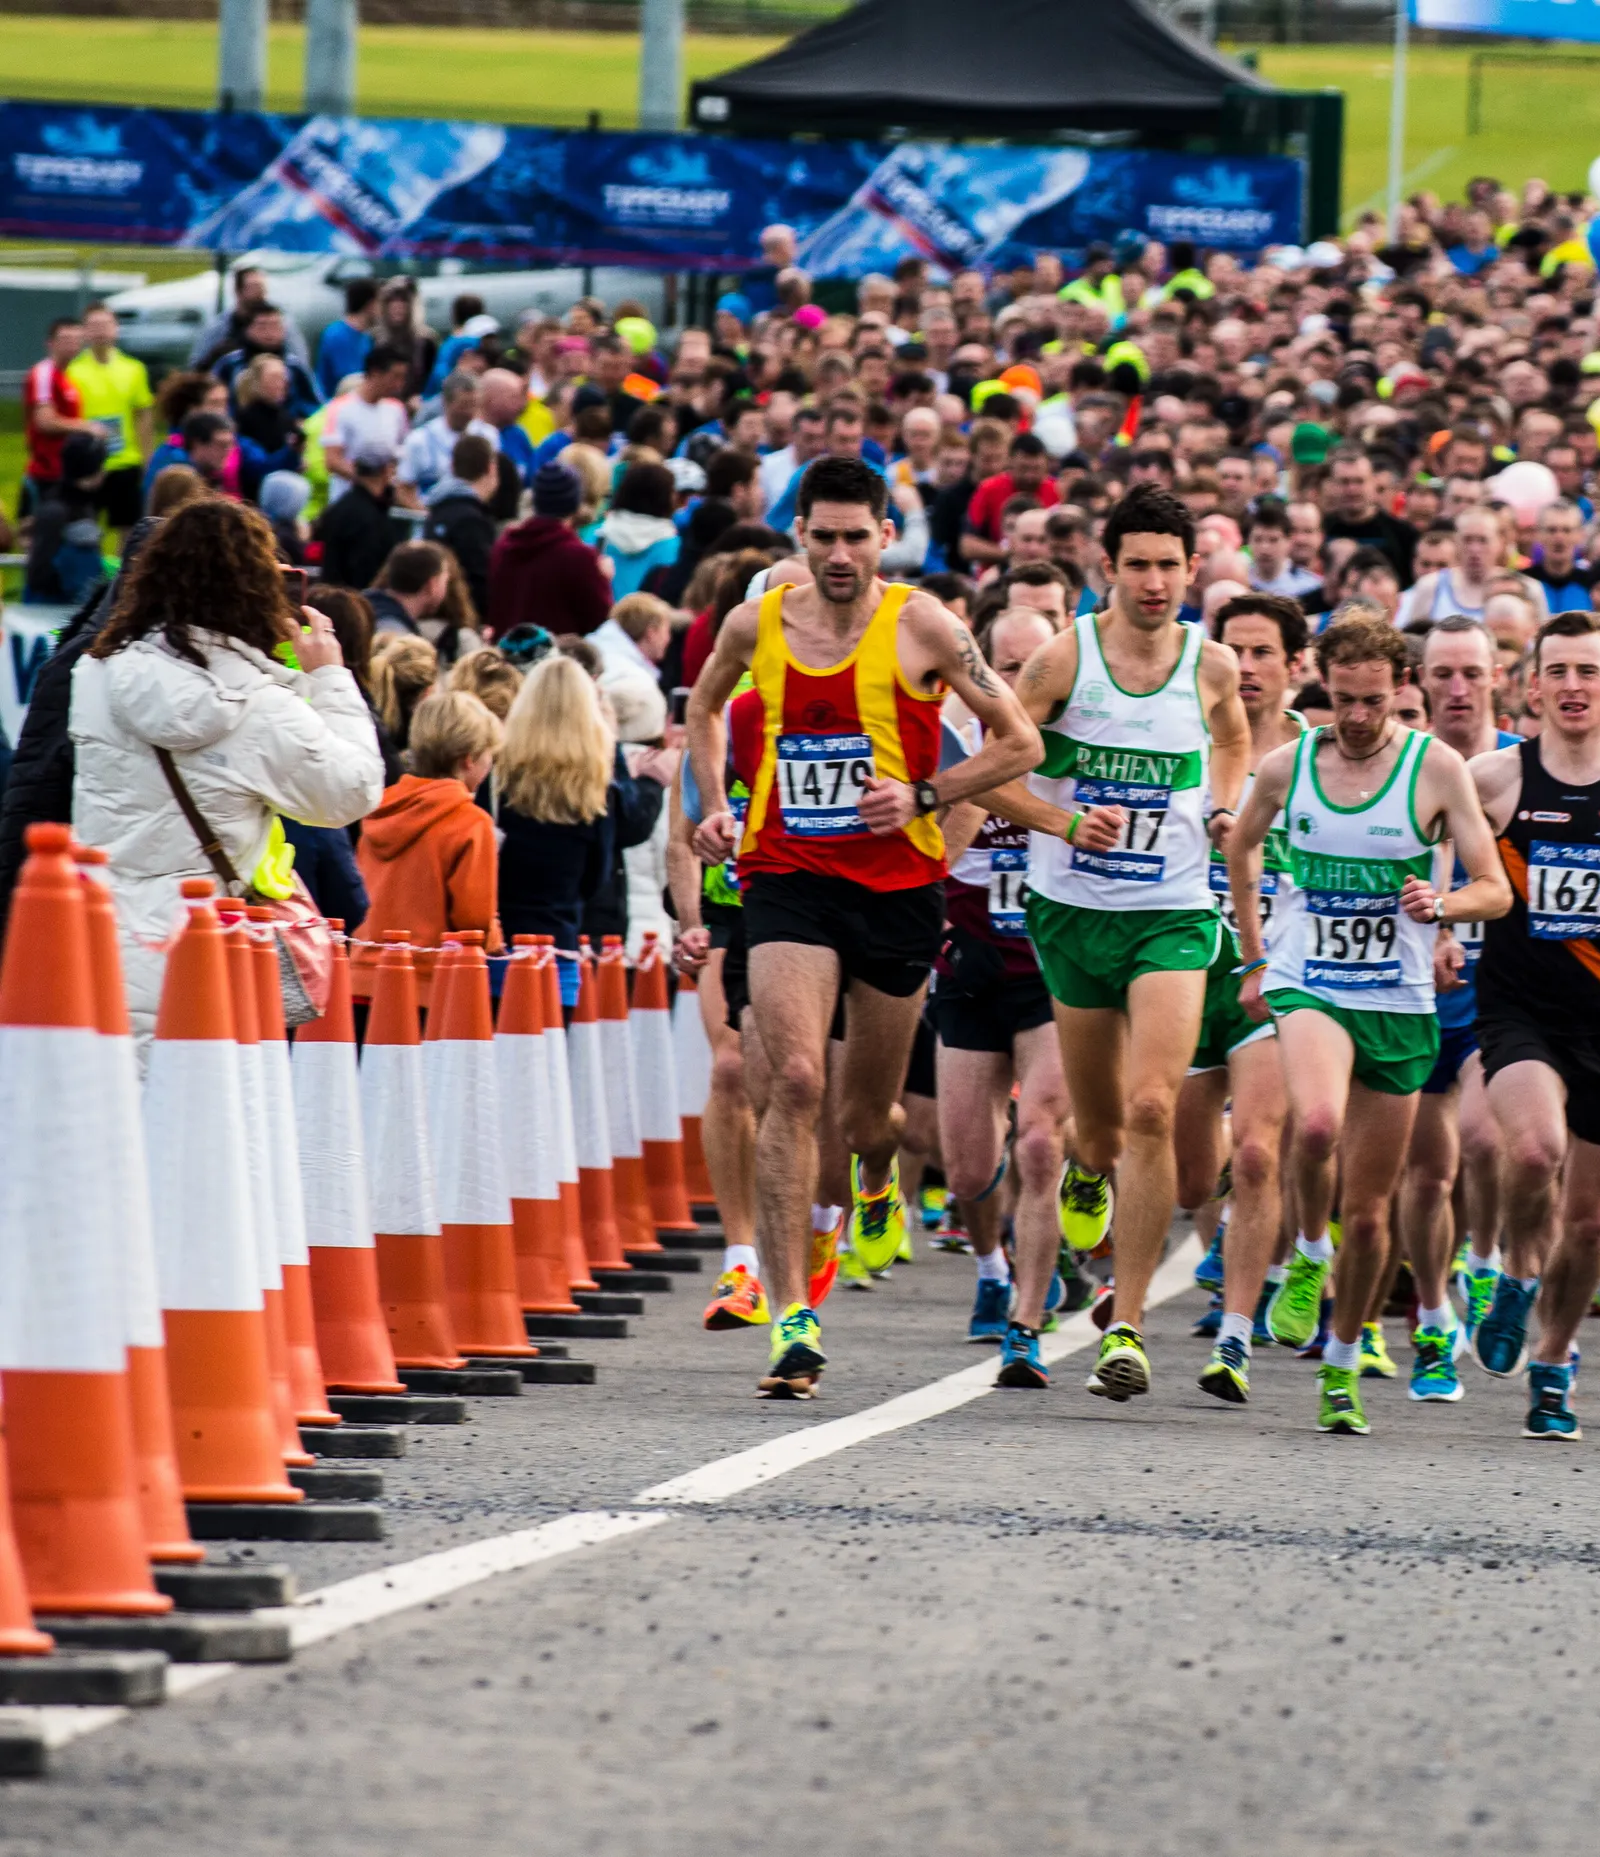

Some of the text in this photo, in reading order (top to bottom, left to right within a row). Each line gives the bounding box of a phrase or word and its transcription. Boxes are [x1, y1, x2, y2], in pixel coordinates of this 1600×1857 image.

[785, 760, 872, 806] 1479
[1076, 747, 1181, 786] RAHENY
[1315, 916, 1396, 960] 1599
